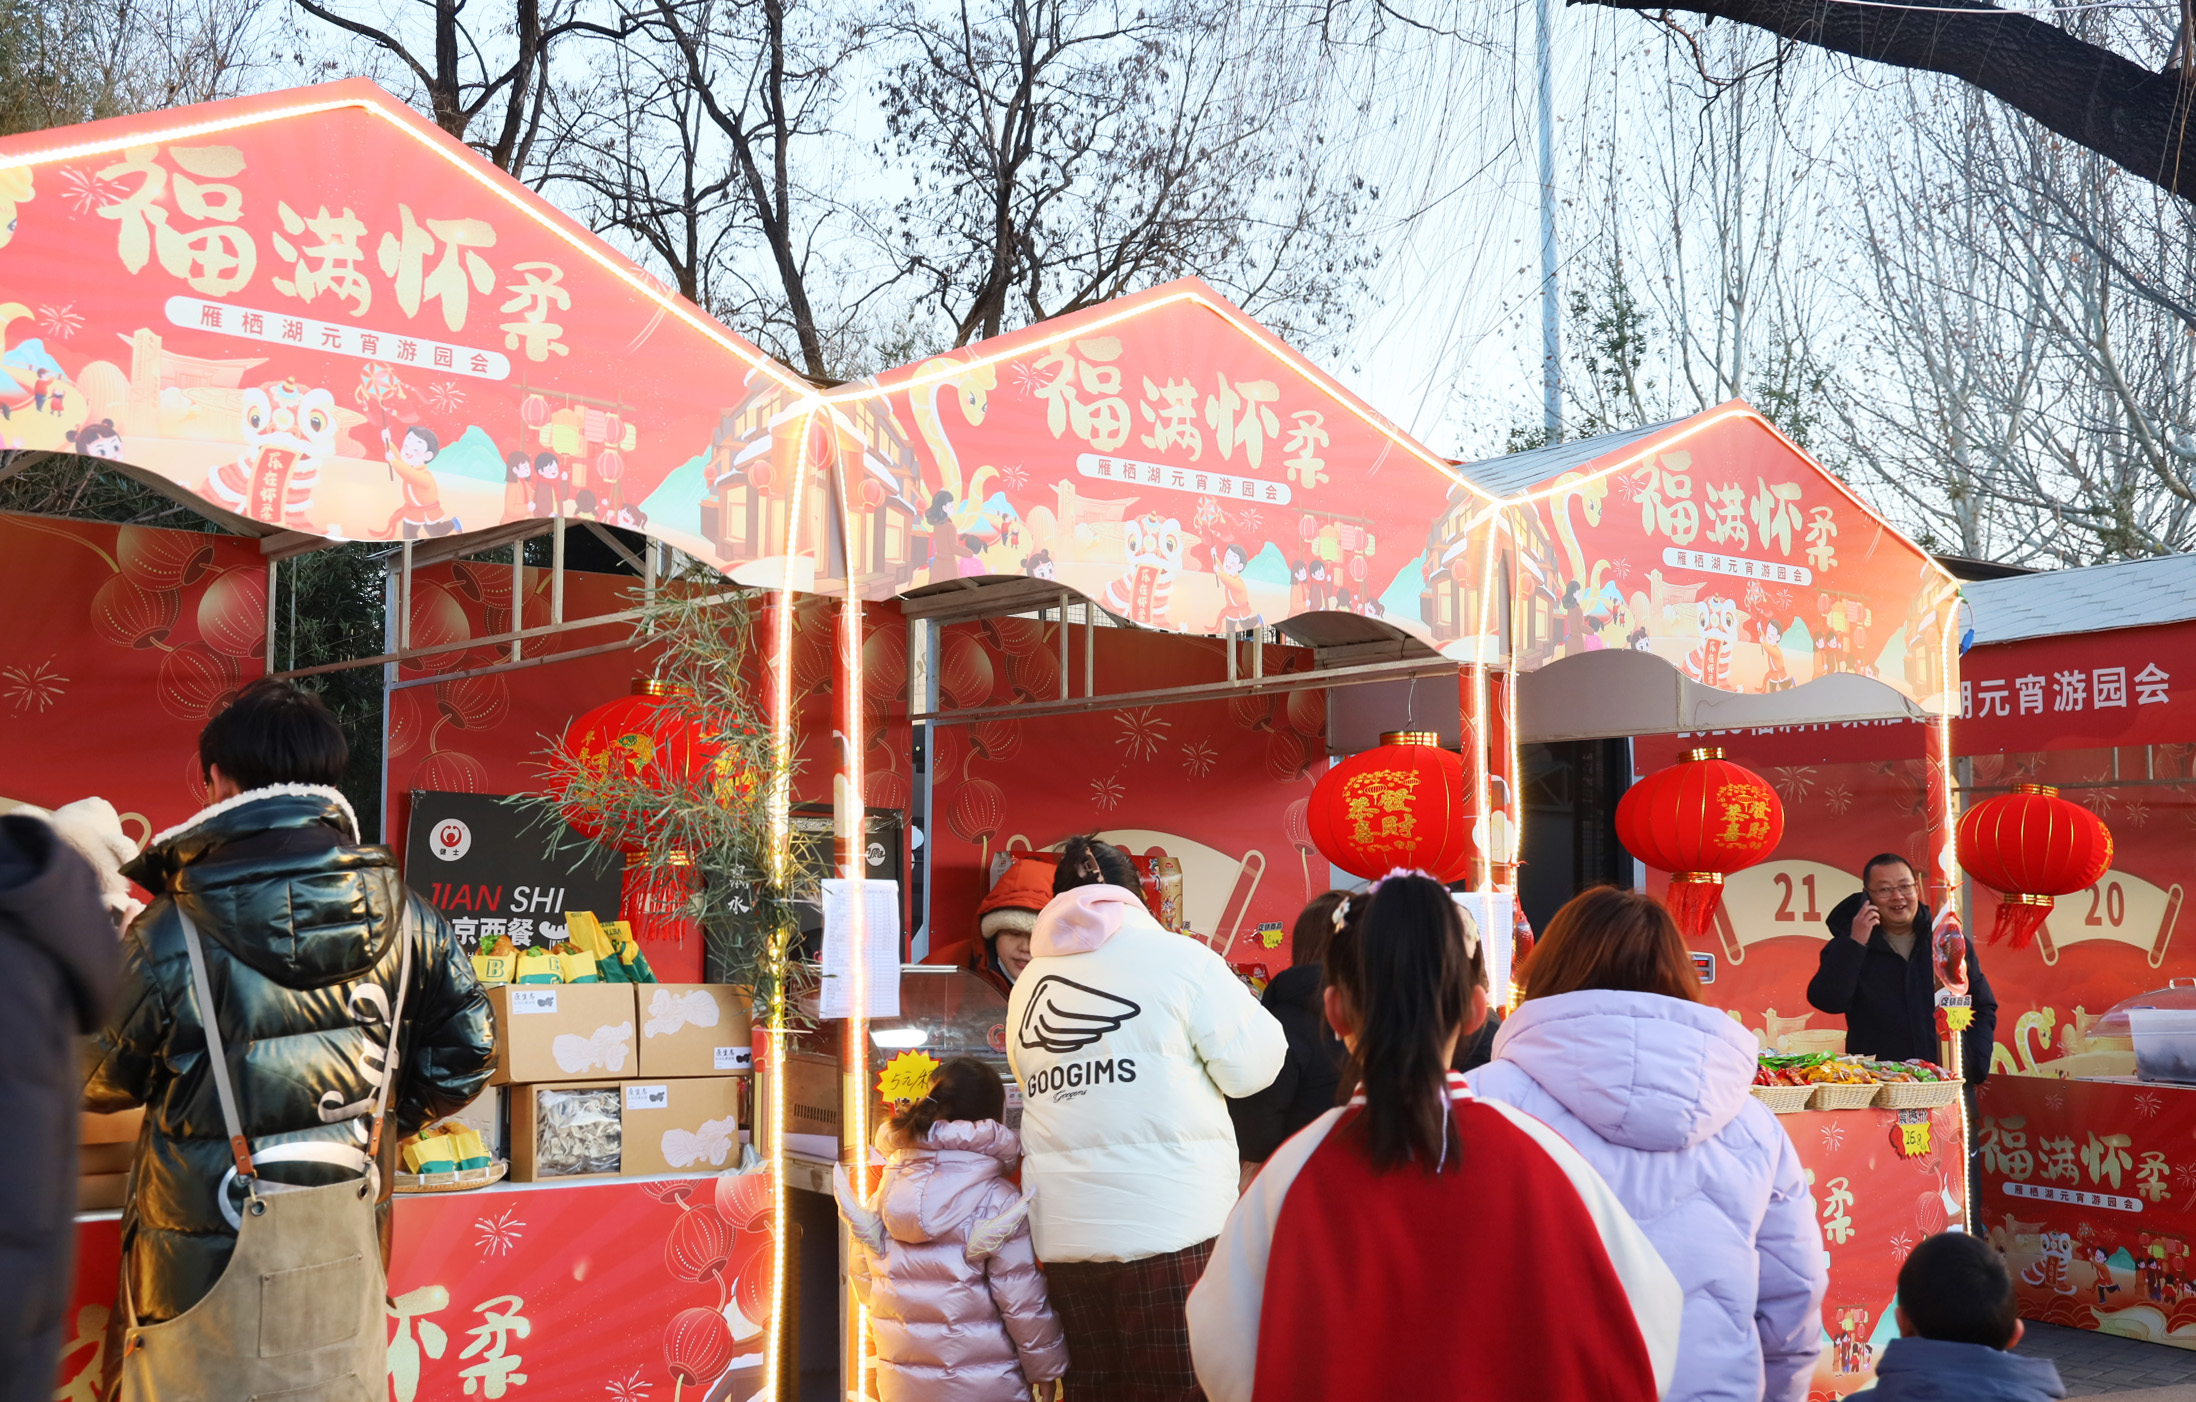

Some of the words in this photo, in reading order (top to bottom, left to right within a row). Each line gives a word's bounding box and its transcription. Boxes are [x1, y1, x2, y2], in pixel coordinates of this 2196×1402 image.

[97, 142, 571, 362] 福满怀柔
[200, 303, 490, 375] 雁栖湖元宵游园会
[1034, 334, 1329, 489] 福满怀柔
[1097, 458, 1278, 502] 雁栖湖元宵游园会
[1631, 450, 1838, 572] 福满怀柔
[1676, 551, 1803, 583] 雁栖湖元宵游园会
[432, 882, 503, 911] JIAN
[510, 885, 565, 914] SHI
[1774, 872, 1821, 922] 21
[2085, 881, 2124, 927] 20
[447, 916, 534, 947] 京西餐
[1027, 1058, 1137, 1098] GOOGIMS
[1978, 1114, 2172, 1203] 福满怀柔
[2014, 1184, 2134, 1210] 雁栖湖元宵游园会
